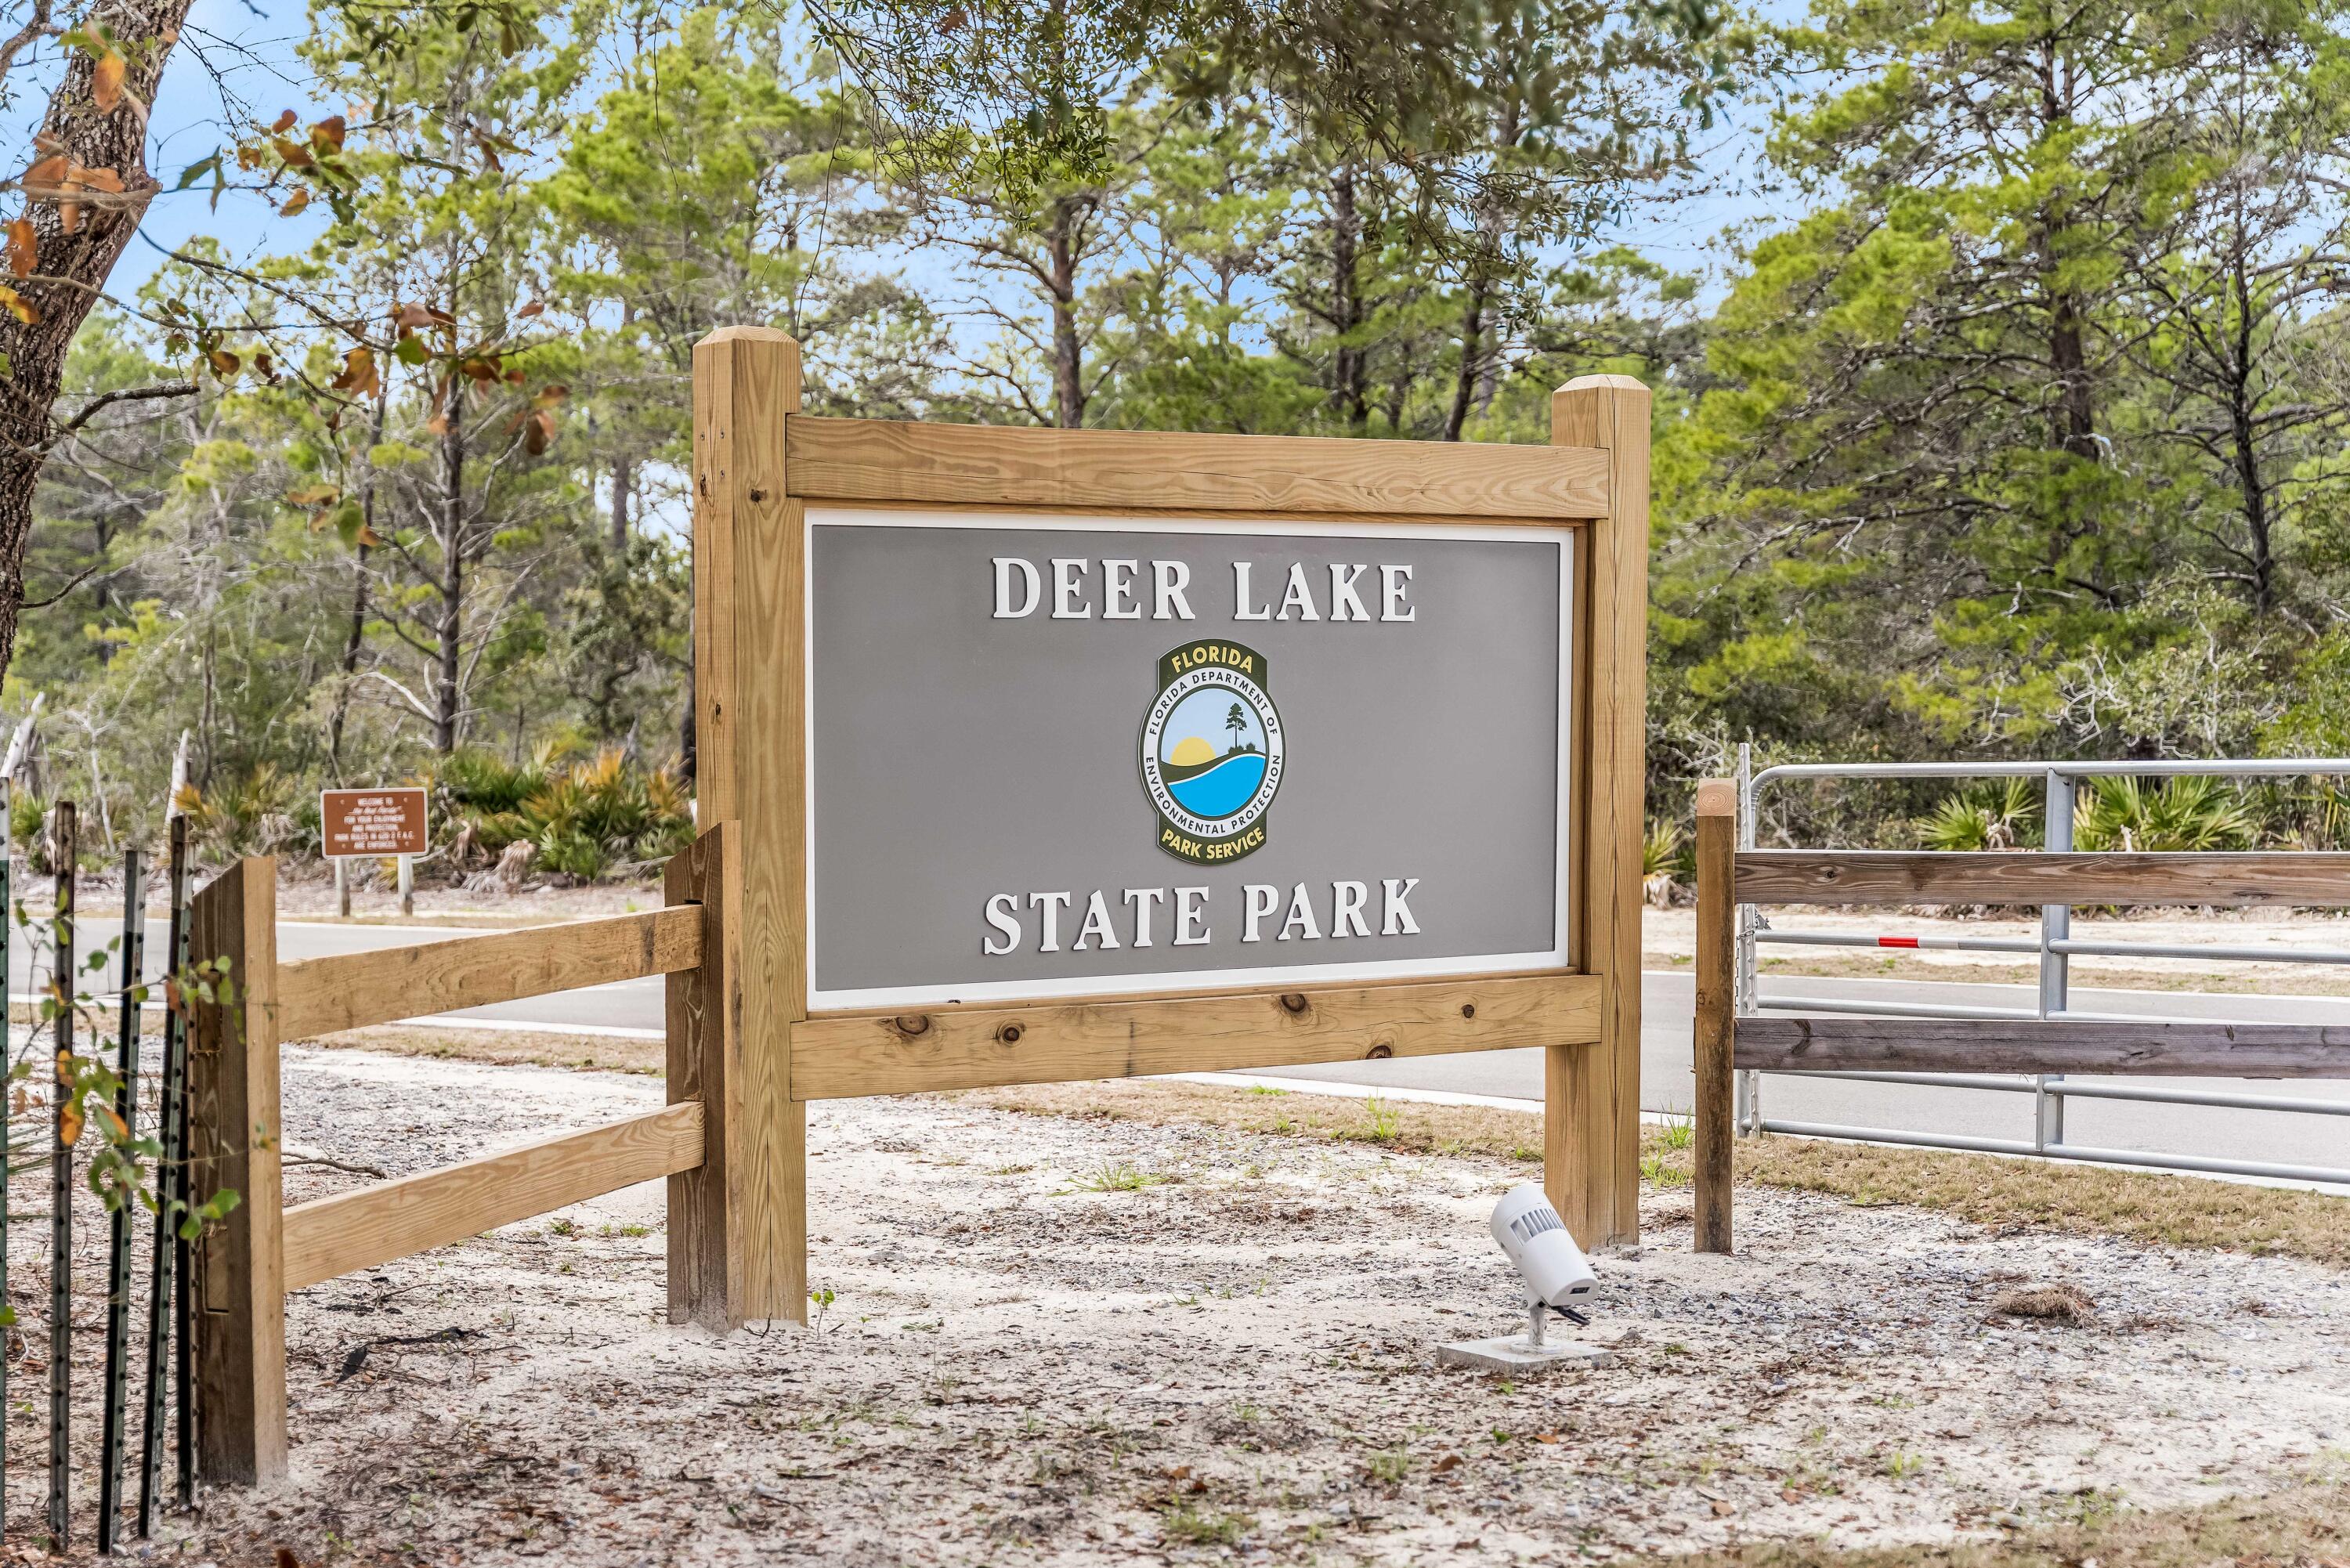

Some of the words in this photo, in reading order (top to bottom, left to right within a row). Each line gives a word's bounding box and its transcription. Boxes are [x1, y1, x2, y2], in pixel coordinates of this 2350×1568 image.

[992, 557, 1195, 620] DEER
[1233, 561, 1415, 621] LAKE
[1171, 645, 1253, 674] FLORIDA
[1149, 681, 1188, 735] FLORIDA
[1191, 671, 1268, 711] DEPARTMENT
[1267, 717, 1278, 735] OF
[1146, 757, 1226, 834] ENVIRONMENTAL
[1231, 755, 1281, 830] PROTECTION
[1161, 829, 1202, 858] PARK
[1206, 826, 1264, 859] SERVICE
[984, 887, 1211, 954] STATE
[1242, 878, 1421, 941] PARK
